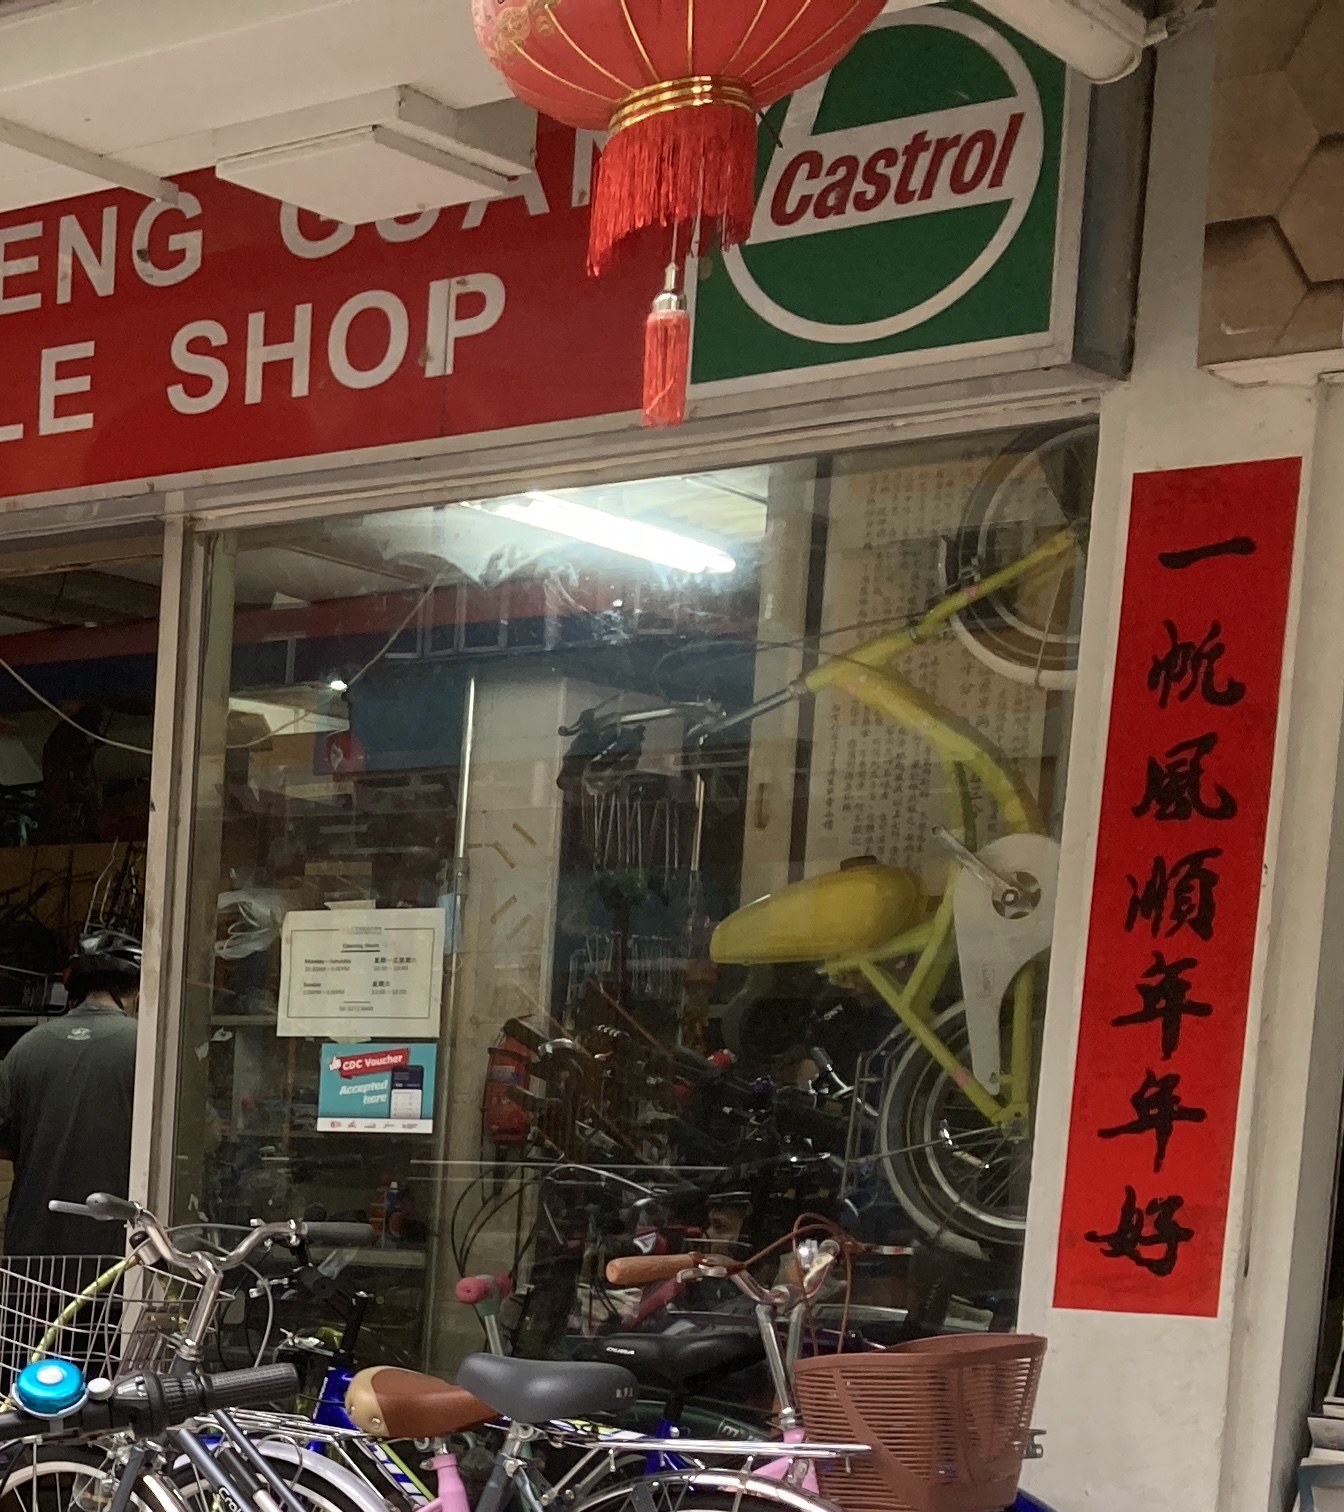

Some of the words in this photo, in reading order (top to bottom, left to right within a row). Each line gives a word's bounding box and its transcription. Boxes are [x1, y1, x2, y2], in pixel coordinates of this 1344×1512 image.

[769, 112, 1023, 228] Castrol
[166, 271, 508, 414] SHOP
[1084, 535, 1257, 1279] 一帆風順年年好
[339, 1079, 389, 1096] Accepted
[342, 1059, 363, 1071] CDC
[364, 1055, 404, 1067] Voucher
[363, 1094, 388, 1105] here
